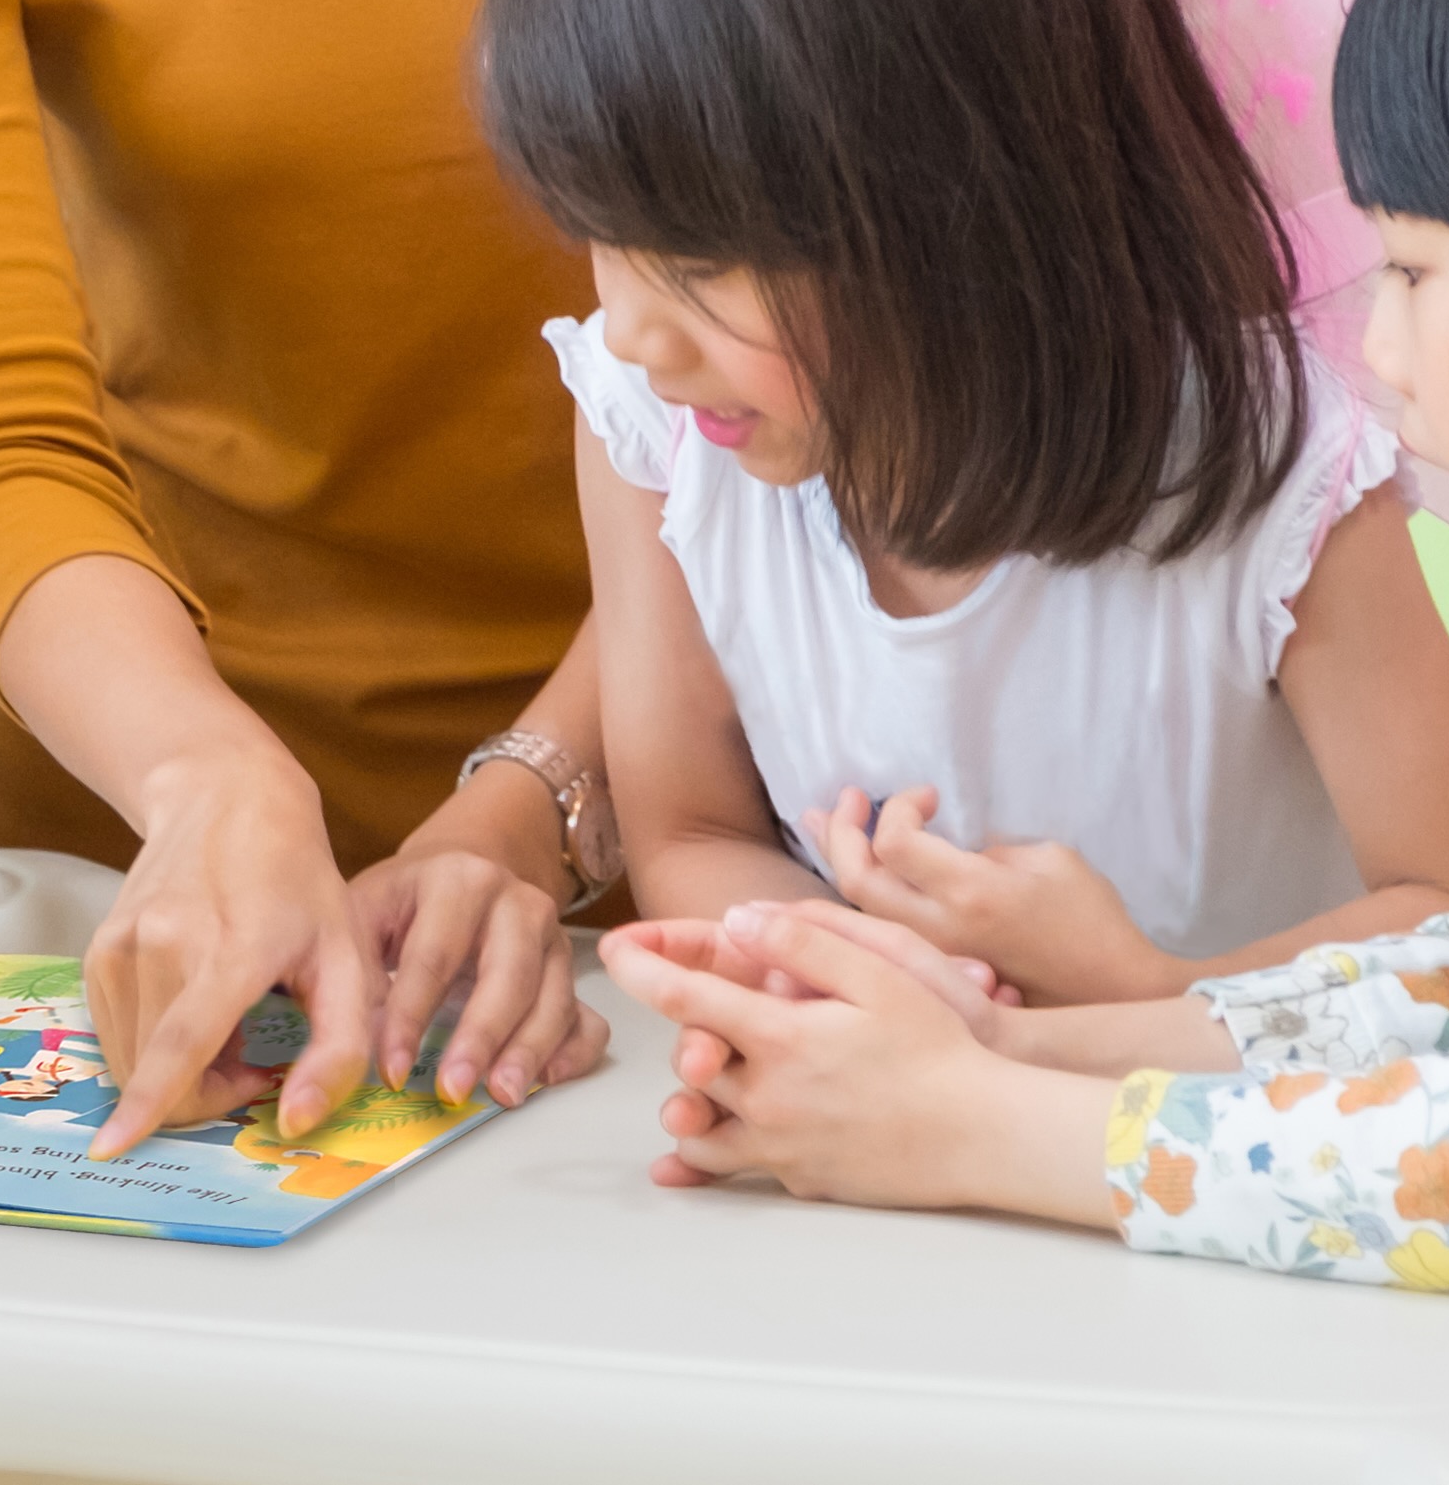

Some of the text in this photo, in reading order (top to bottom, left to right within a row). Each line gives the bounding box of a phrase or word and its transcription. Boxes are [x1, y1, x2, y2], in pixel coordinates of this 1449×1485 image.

[32, 1146, 135, 1166] siling
[137, 1161, 191, 1173] and
[187, 1188, 232, 1203] like
